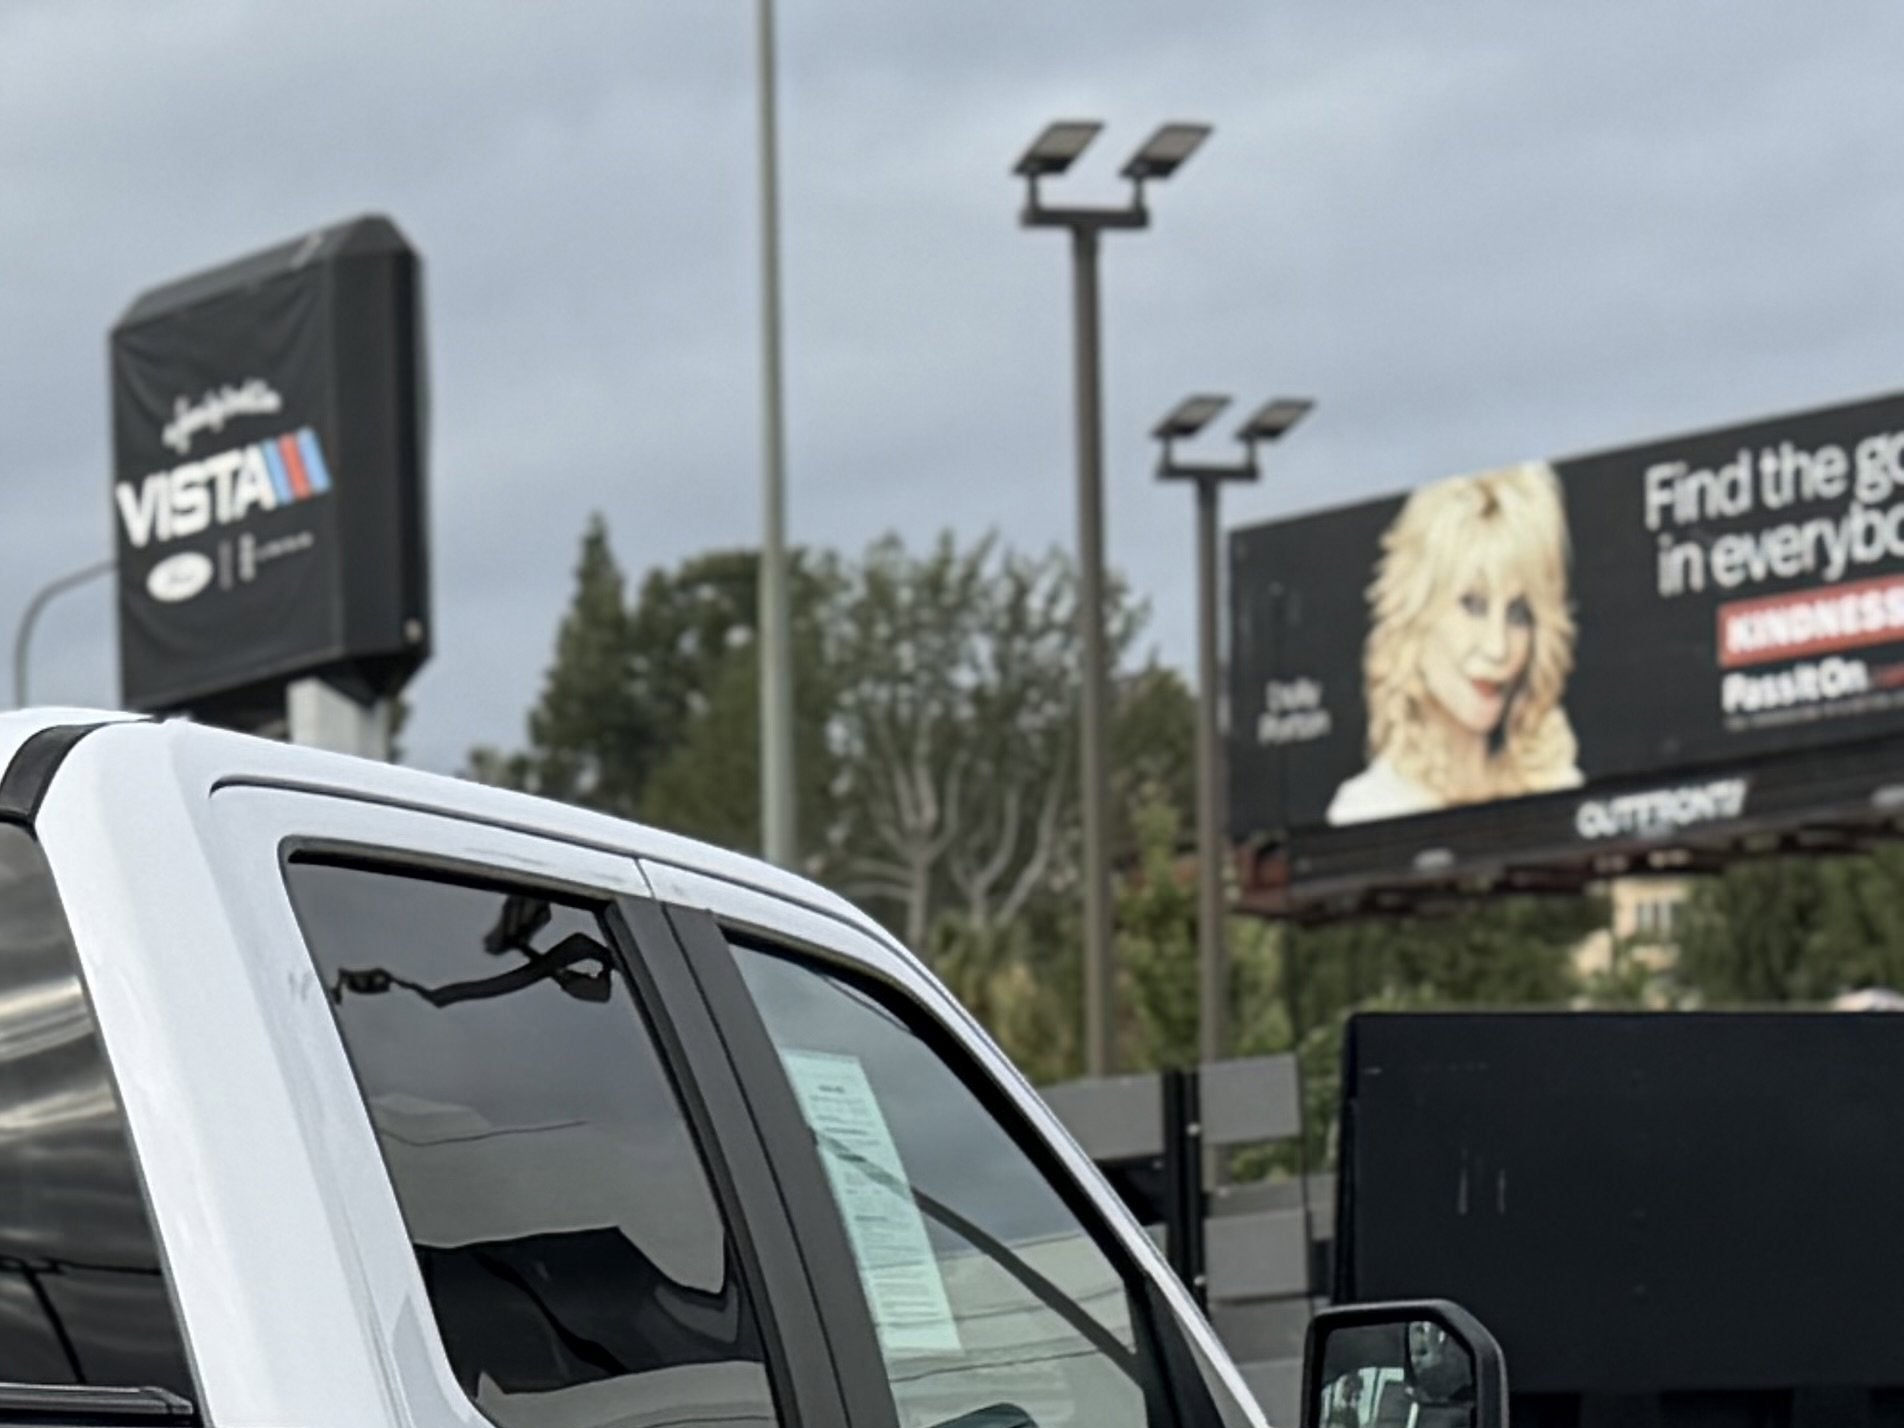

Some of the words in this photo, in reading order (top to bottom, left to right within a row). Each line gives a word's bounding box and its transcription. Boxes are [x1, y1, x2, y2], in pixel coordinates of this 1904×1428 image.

[115, 443, 277, 547] VISTA
[1645, 447, 1753, 531] Find
[1758, 441, 1849, 509] the
[1656, 532, 1706, 597] in
